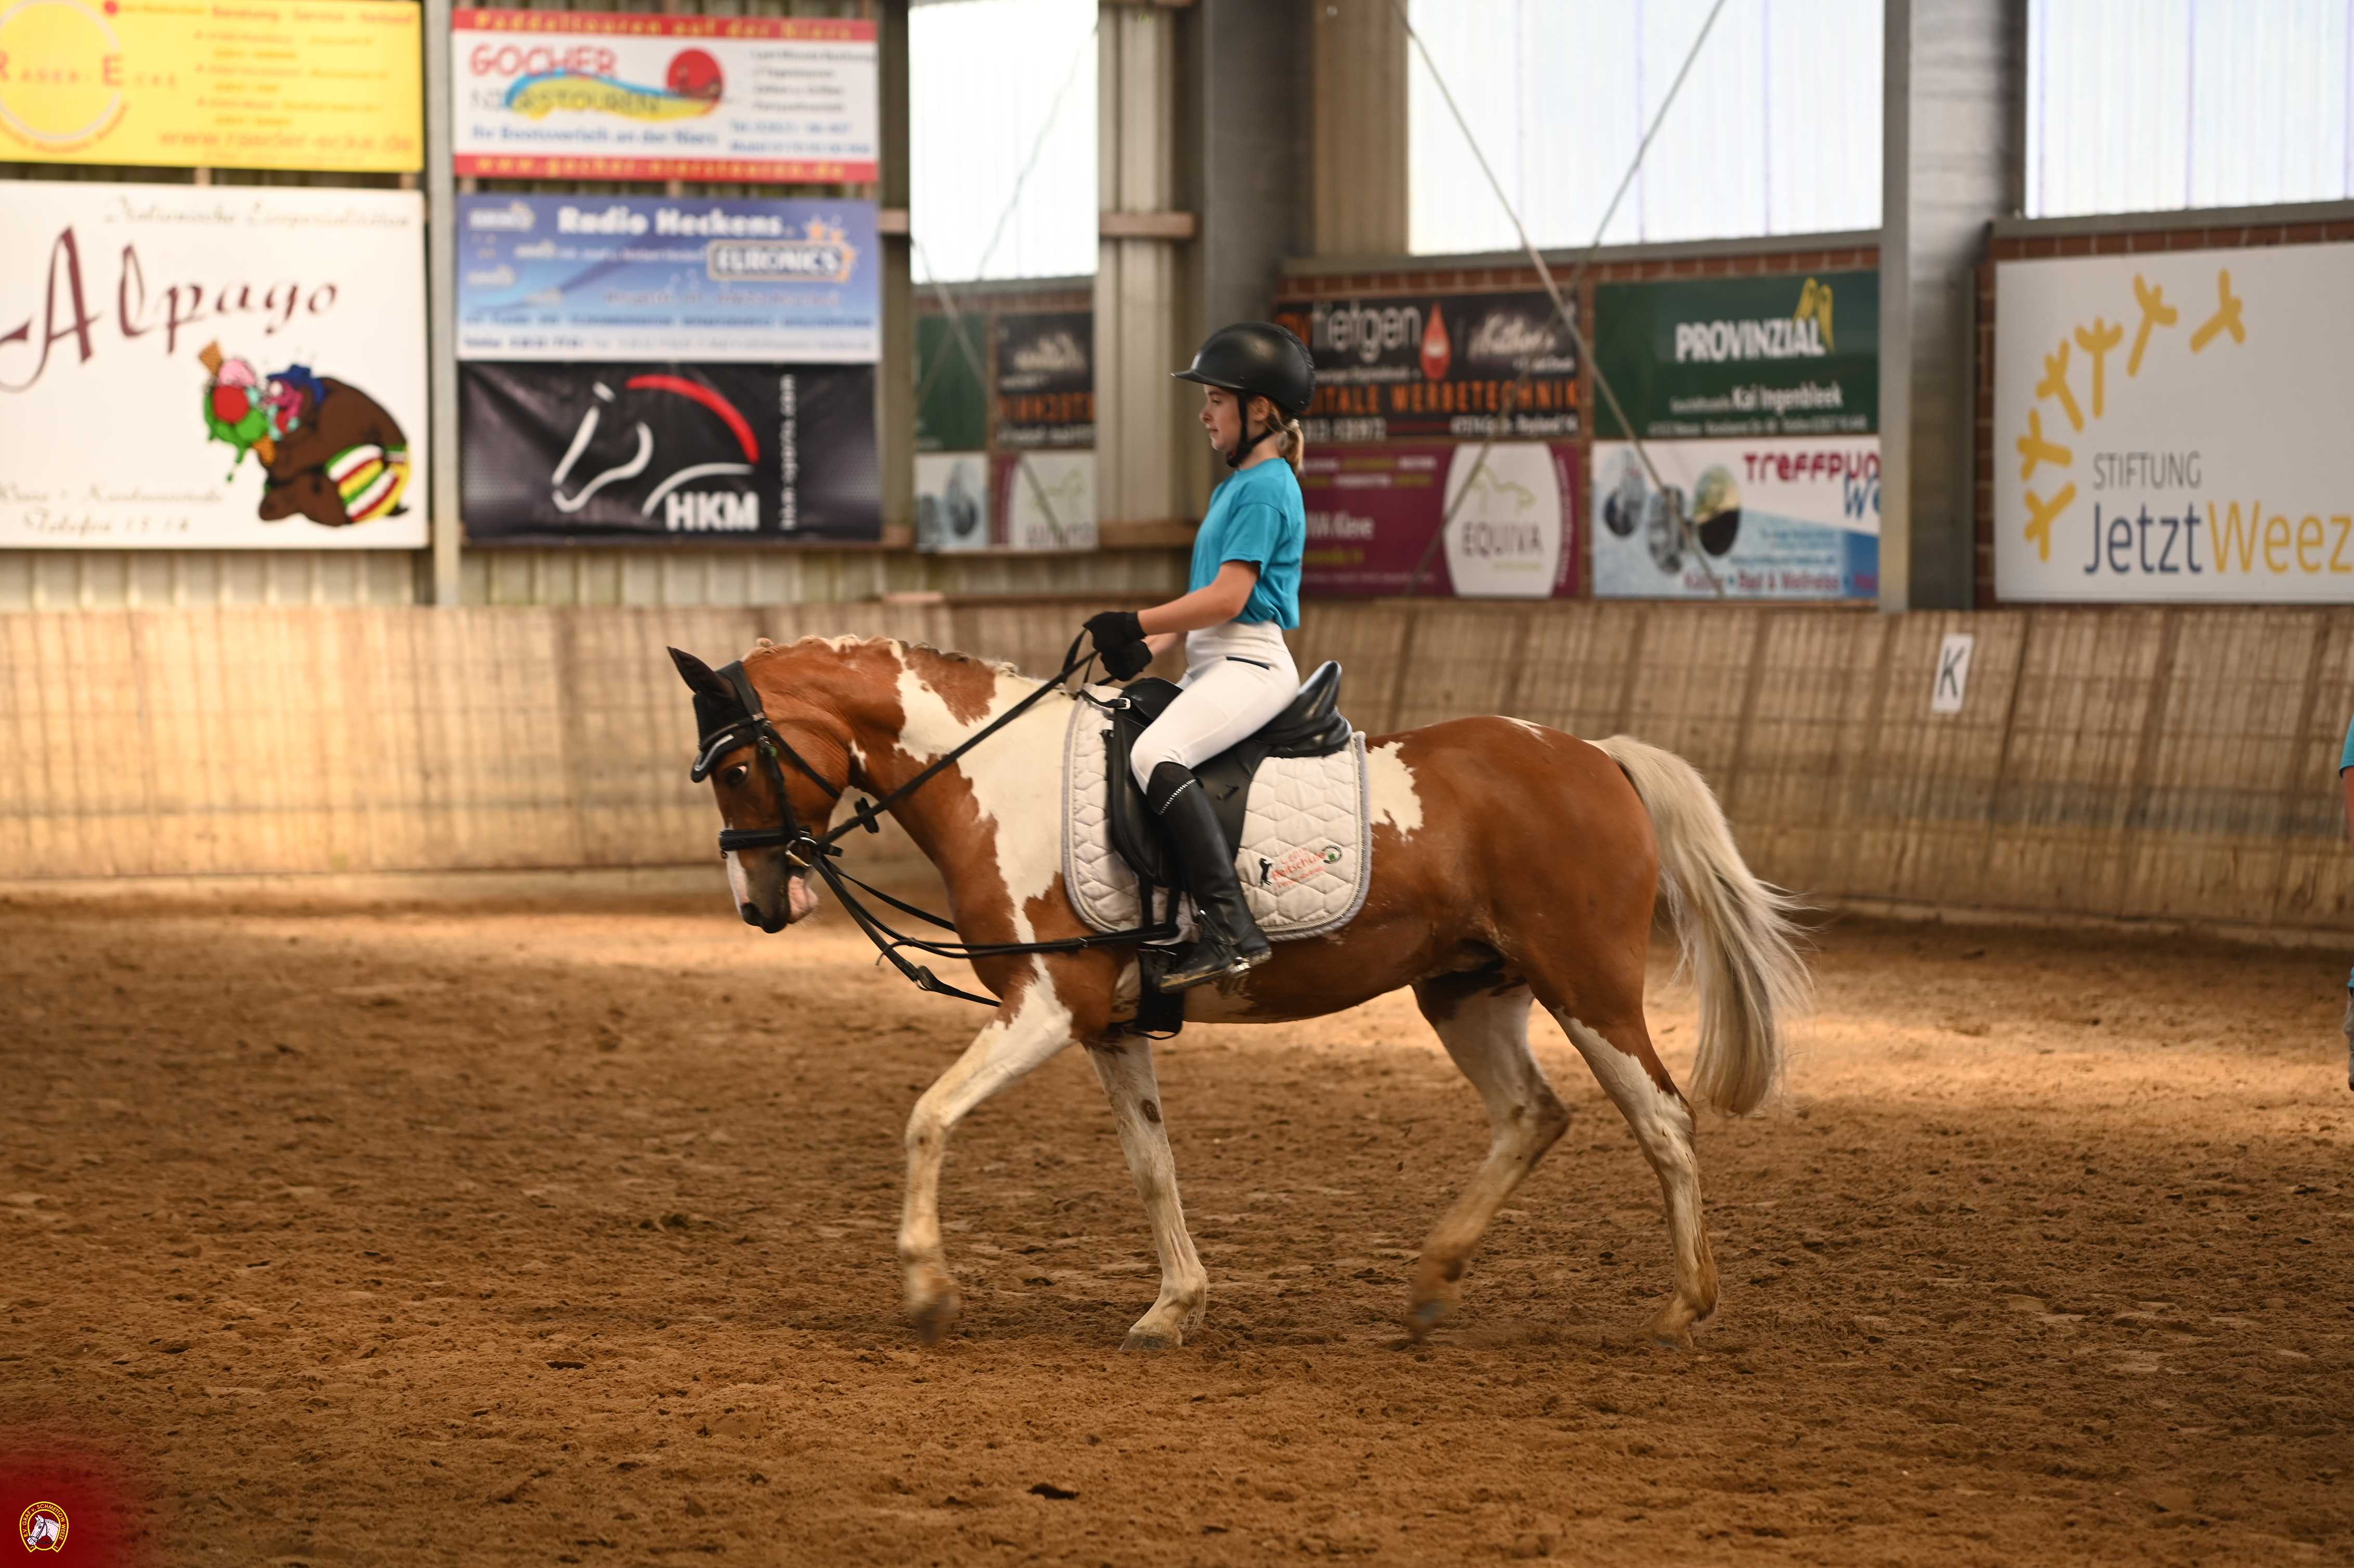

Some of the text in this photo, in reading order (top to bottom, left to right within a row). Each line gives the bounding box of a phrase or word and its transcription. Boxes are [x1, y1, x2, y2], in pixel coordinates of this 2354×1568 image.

[469, 43, 619, 78] GOCHER
[558, 206, 648, 236] Radio
[656, 209, 783, 237] Heckens
[716, 246, 842, 272] EURONICS
[0, 226, 339, 394] Alpago
[1675, 316, 1826, 363] PROVINZIAL
[1732, 383, 1756, 411] Kai
[2092, 450, 2202, 490] STIFTUNG
[666, 492, 759, 531] HKM
[1461, 521, 1545, 558] EQUIVA
[1938, 646, 1965, 698] K
